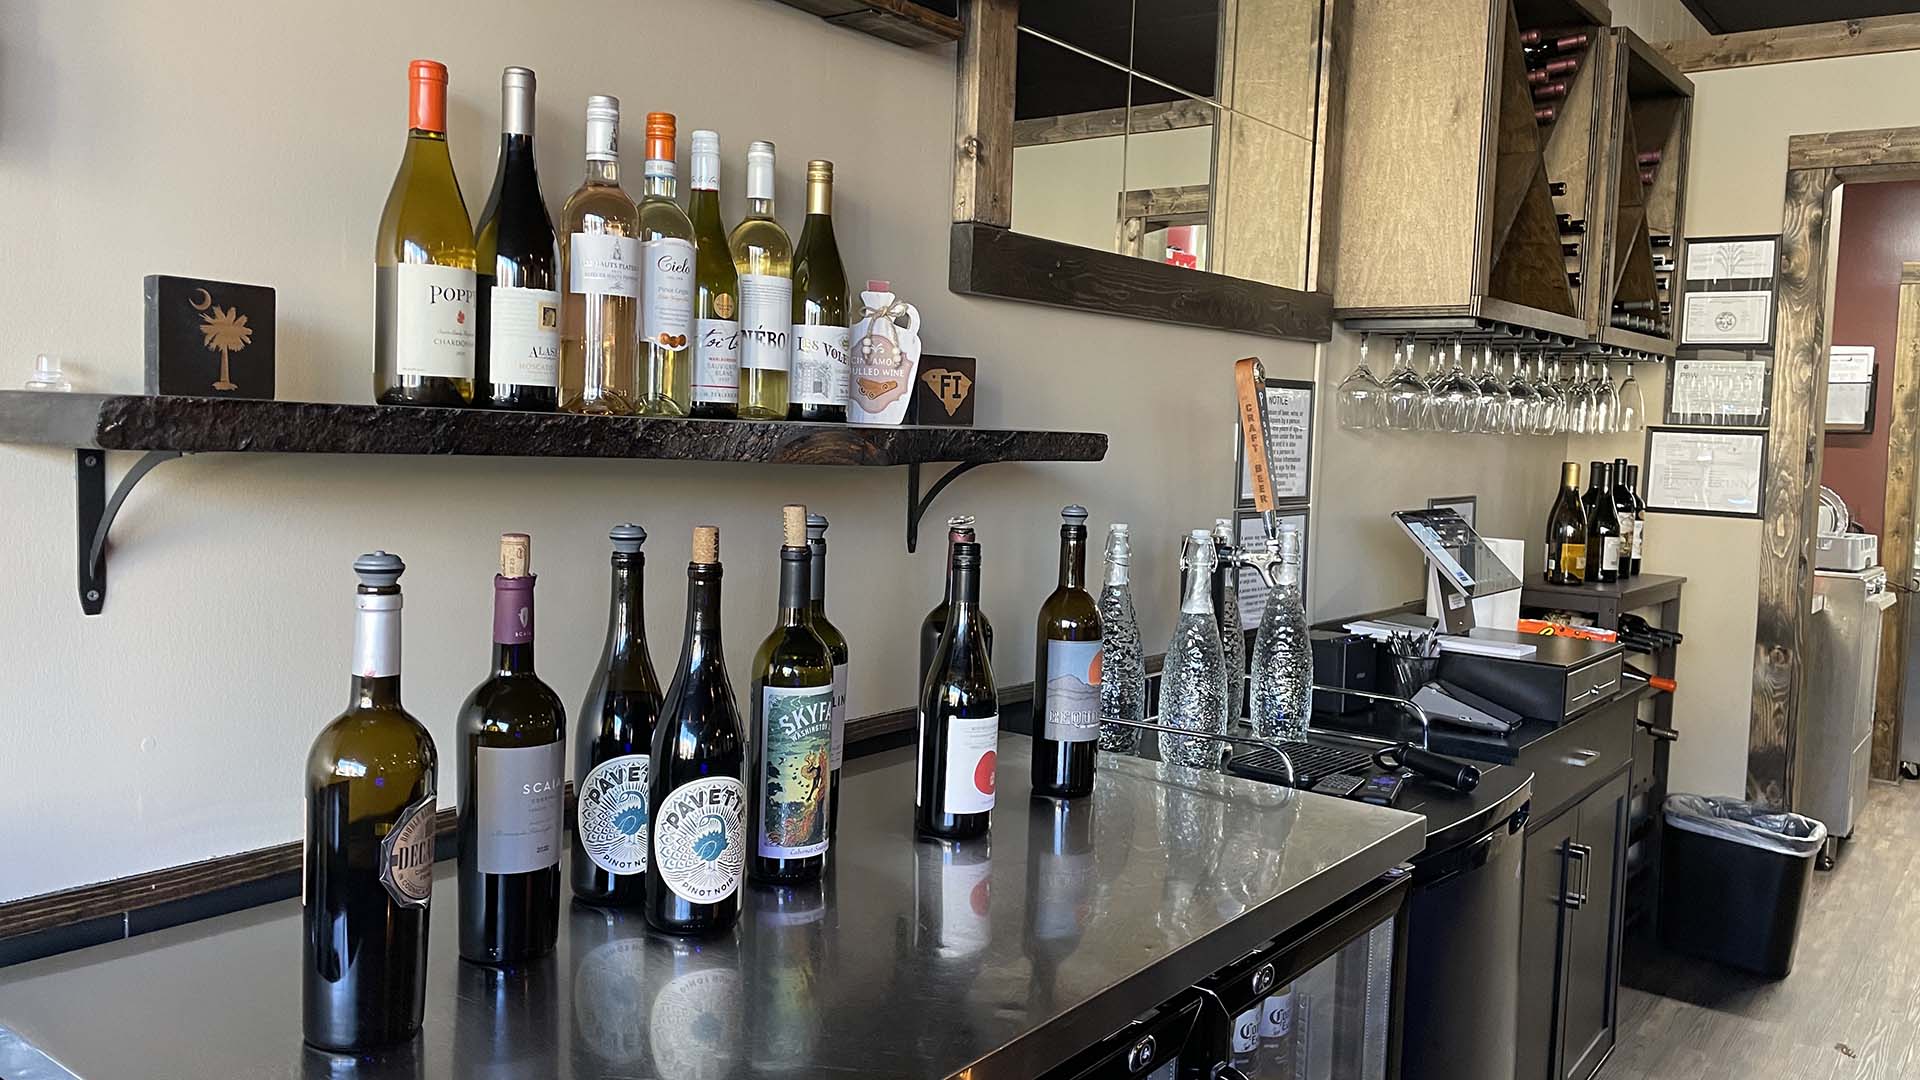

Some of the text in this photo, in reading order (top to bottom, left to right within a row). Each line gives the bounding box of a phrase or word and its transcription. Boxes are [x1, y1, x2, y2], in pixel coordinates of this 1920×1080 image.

[658, 255, 690, 274] Cielo
[430, 285, 475, 304] POPP
[852, 368, 905, 378] ULLED WINE
[1246, 403, 1268, 504] CRAFT BEER
[603, 853, 632, 869] PINOT
[682, 876, 734, 897] PINOT NOIR
